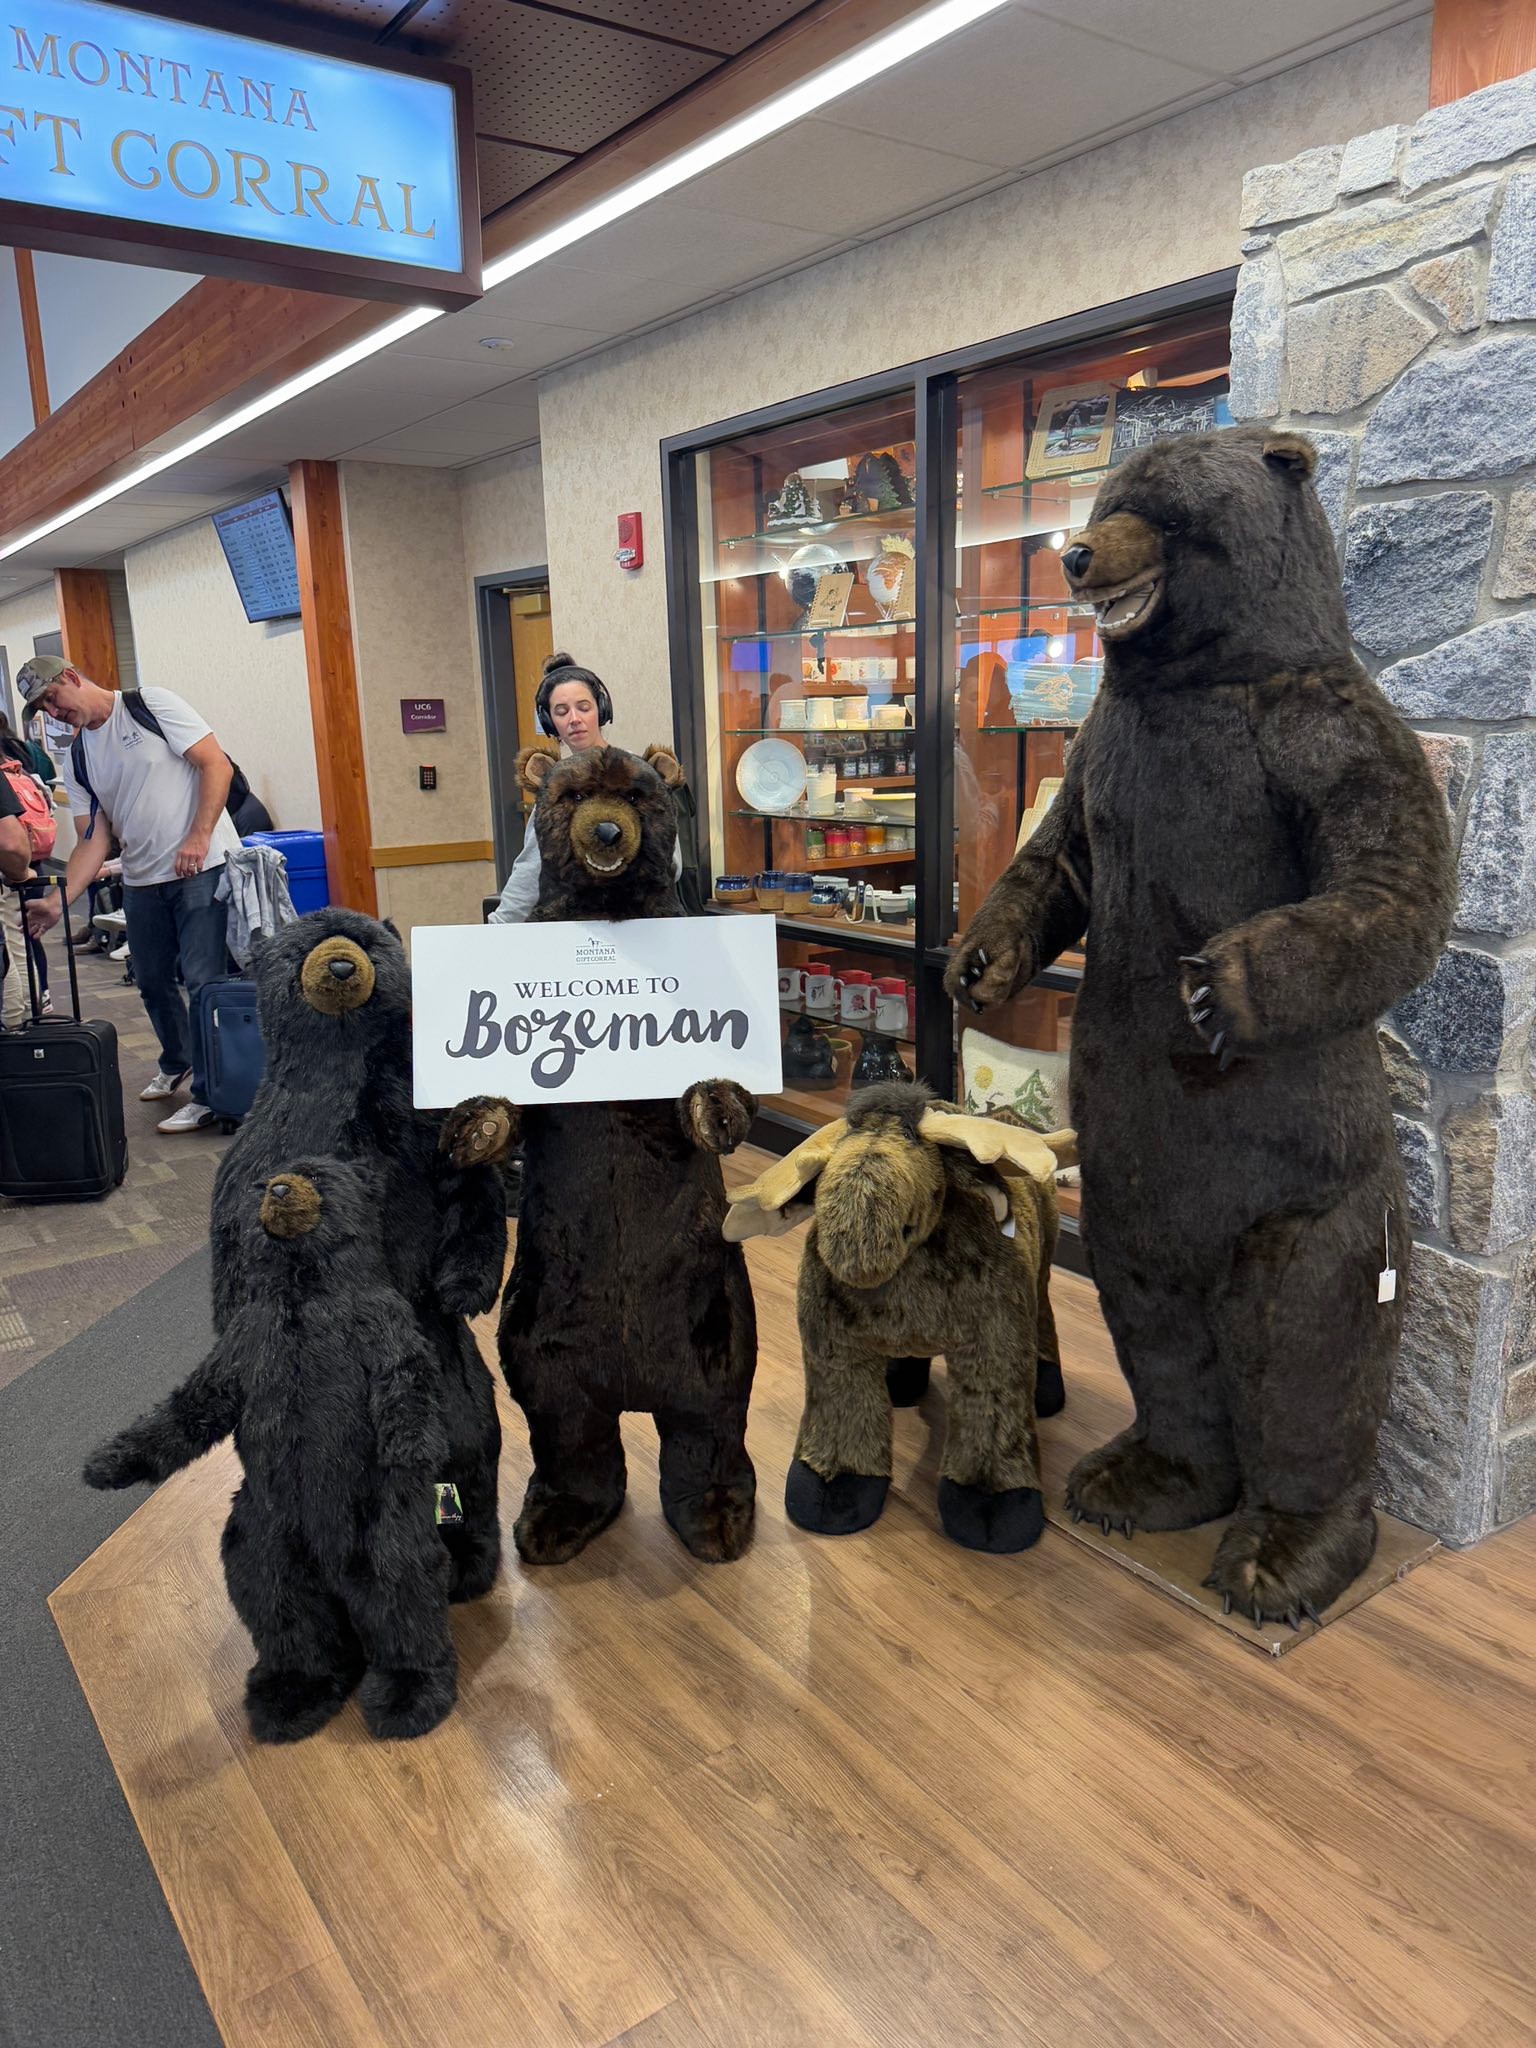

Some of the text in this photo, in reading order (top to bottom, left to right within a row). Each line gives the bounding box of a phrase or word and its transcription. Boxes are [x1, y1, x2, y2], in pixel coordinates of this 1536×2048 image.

[9, 25, 318, 133] MONTANA
[110, 129, 437, 241] CORRAL
[513, 976, 680, 999] WELCOME TO
[576, 948, 616, 956] MONTANA
[445, 989, 749, 1089] Bozeman
